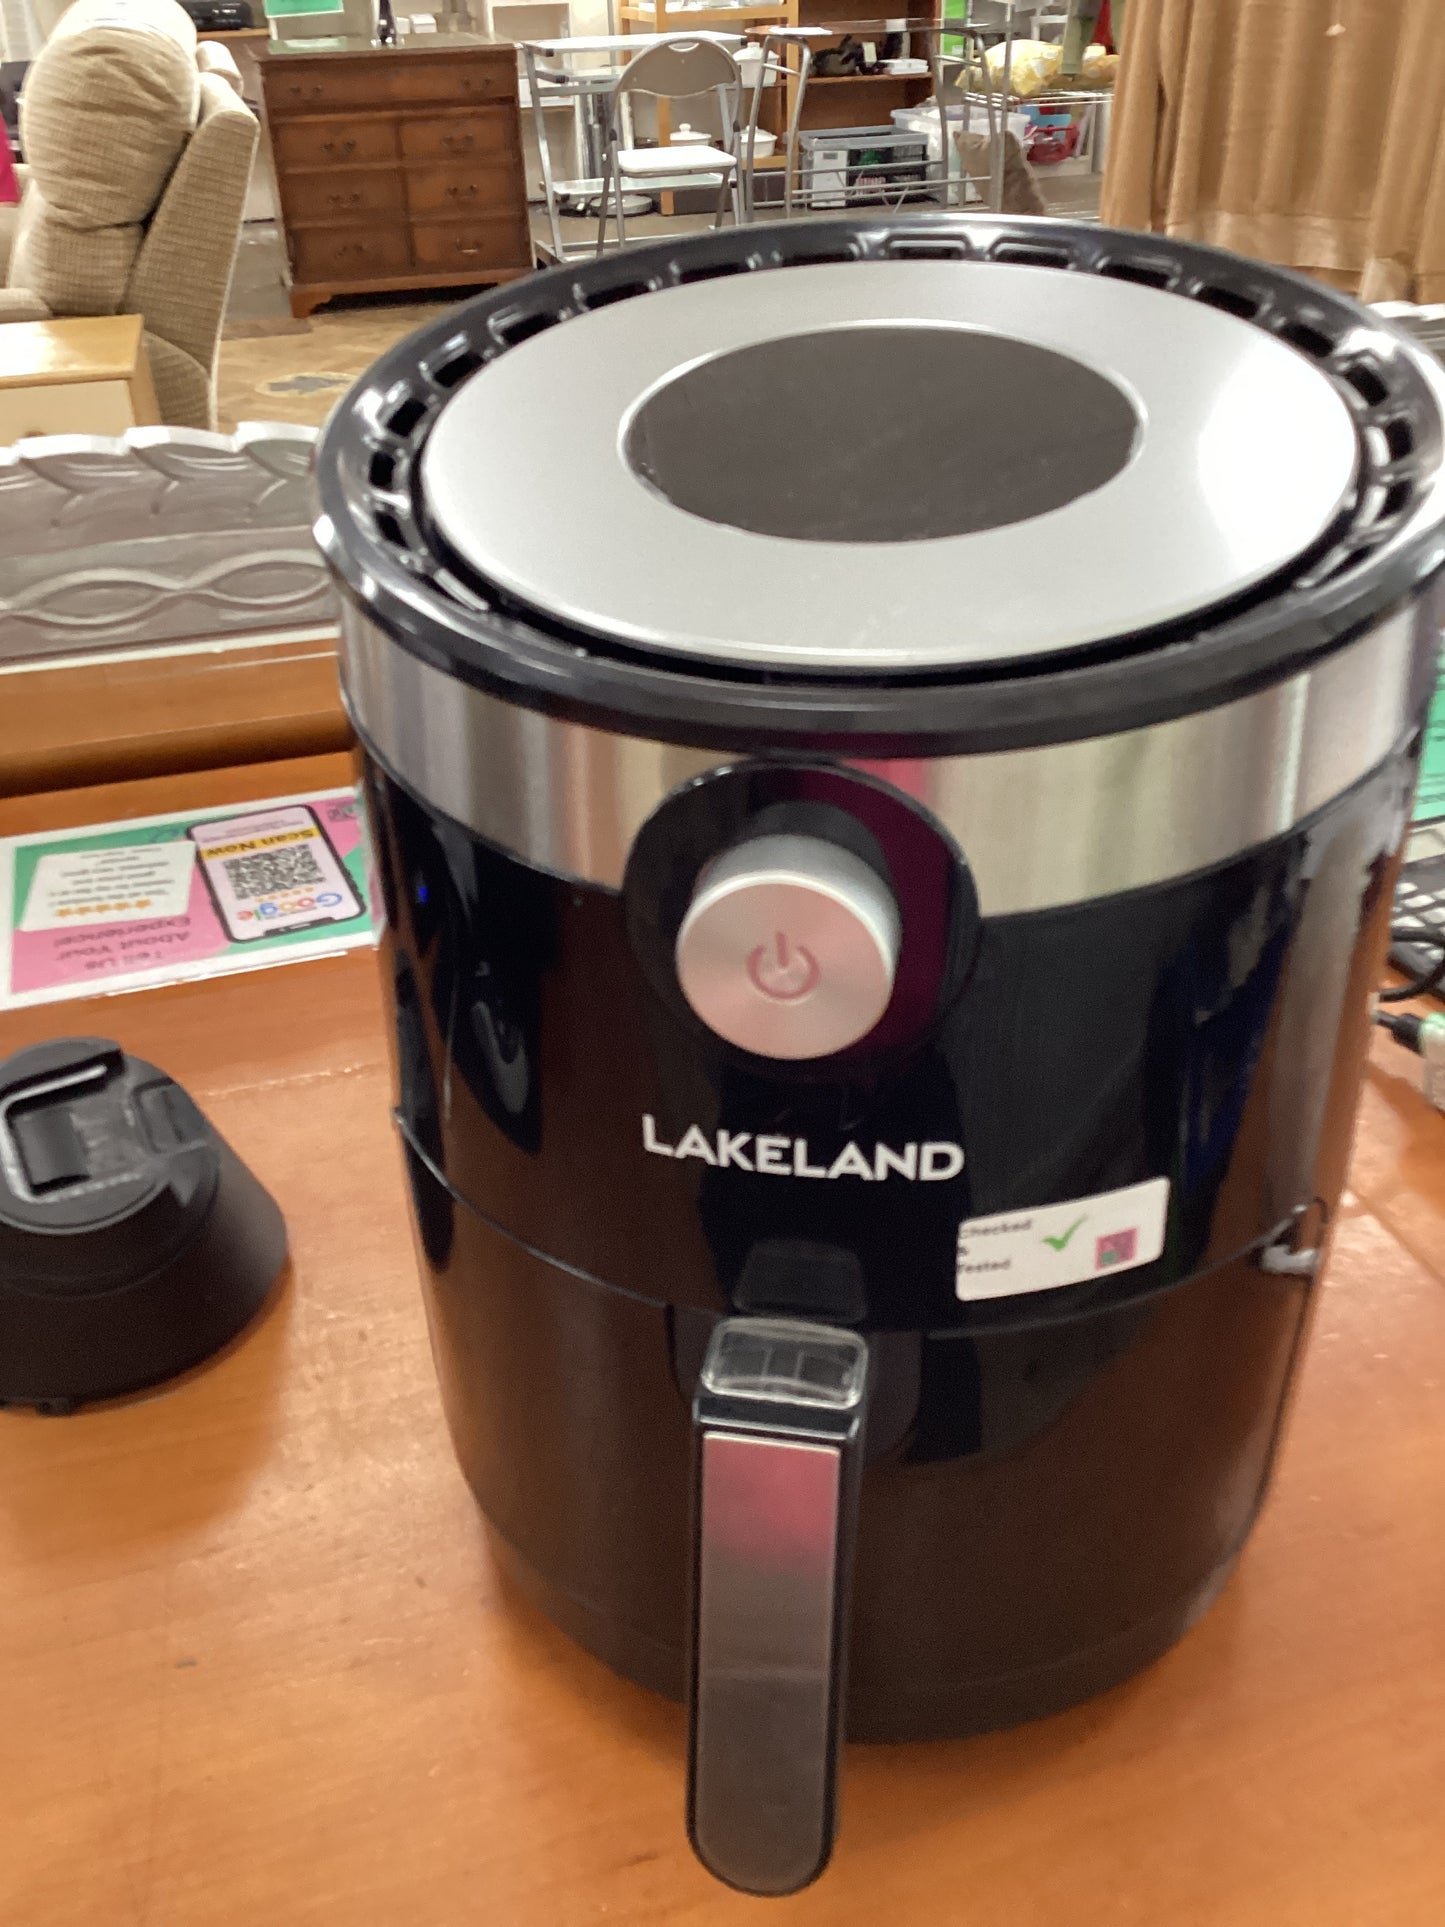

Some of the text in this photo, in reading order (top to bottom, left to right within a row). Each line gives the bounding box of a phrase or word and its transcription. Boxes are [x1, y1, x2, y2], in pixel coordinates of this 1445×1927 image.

[206, 841, 256, 857] Now
[262, 829, 314, 845] Scan
[237, 892, 343, 921] Google
[56, 932, 189, 960] About Your
[642, 1113, 965, 1181] LAKELAND
